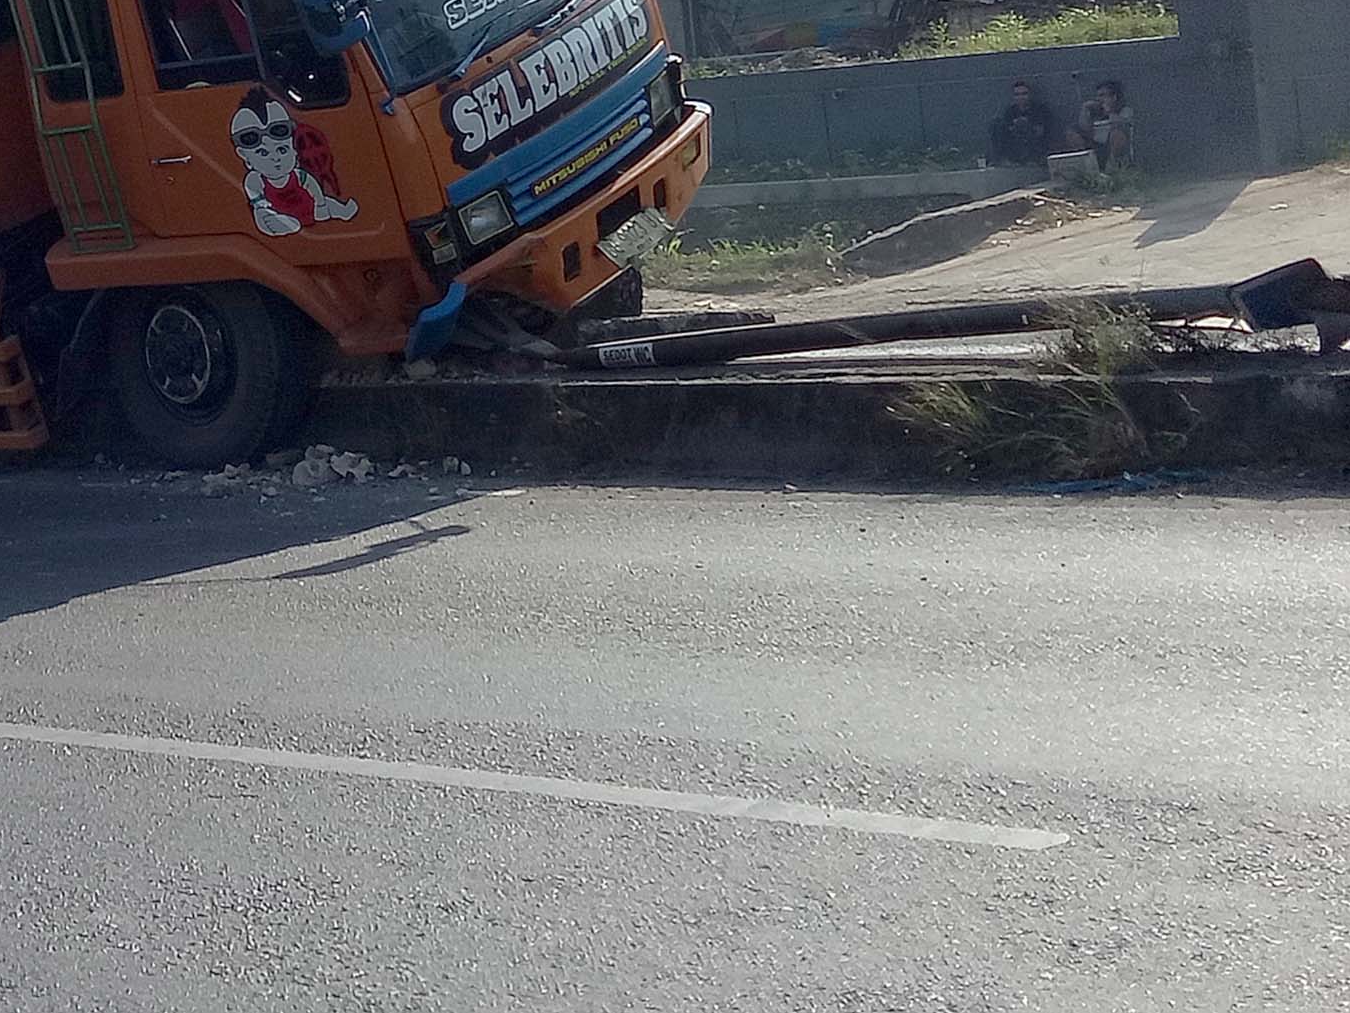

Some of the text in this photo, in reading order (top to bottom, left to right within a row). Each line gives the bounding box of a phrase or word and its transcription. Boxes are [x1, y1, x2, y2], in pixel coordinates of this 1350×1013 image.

[533, 118, 639, 195] MITSUBISHI FUSO
[603, 345, 651, 362] SEDOT WC
